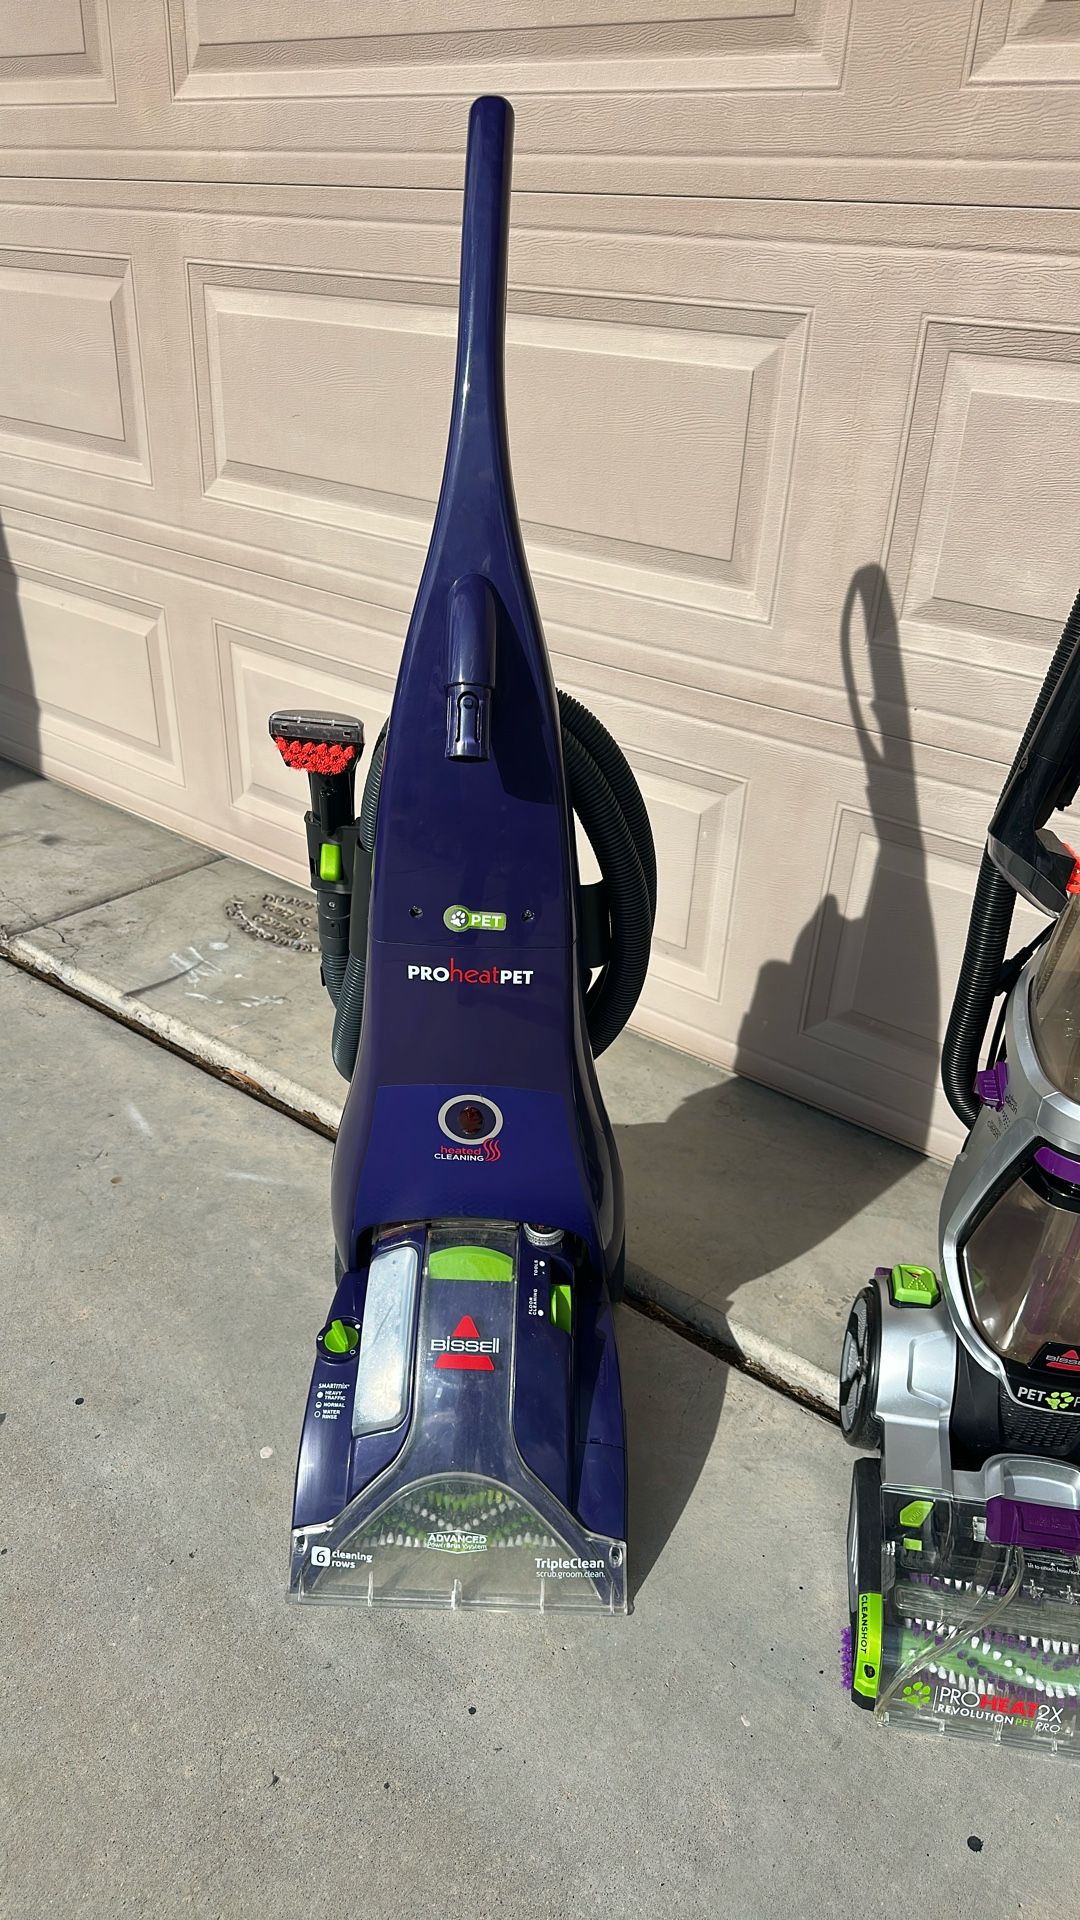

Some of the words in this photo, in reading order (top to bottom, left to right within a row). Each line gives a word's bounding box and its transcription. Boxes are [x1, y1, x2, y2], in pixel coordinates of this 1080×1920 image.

[471, 914, 502, 927] PET
[440, 1145, 481, 1155] heated
[434, 1153, 484, 1162] CLEANING
[1017, 1386, 1047, 1402] PET
[428, 1533, 487, 1545] ADVANCED
[316, 1550, 326, 1563] 6
[331, 1550, 373, 1563] cleaning
[331, 1560, 356, 1569] rows
[534, 1558, 605, 1571] TripleClean
[937, 1703, 1015, 1725] REVOLUTION
